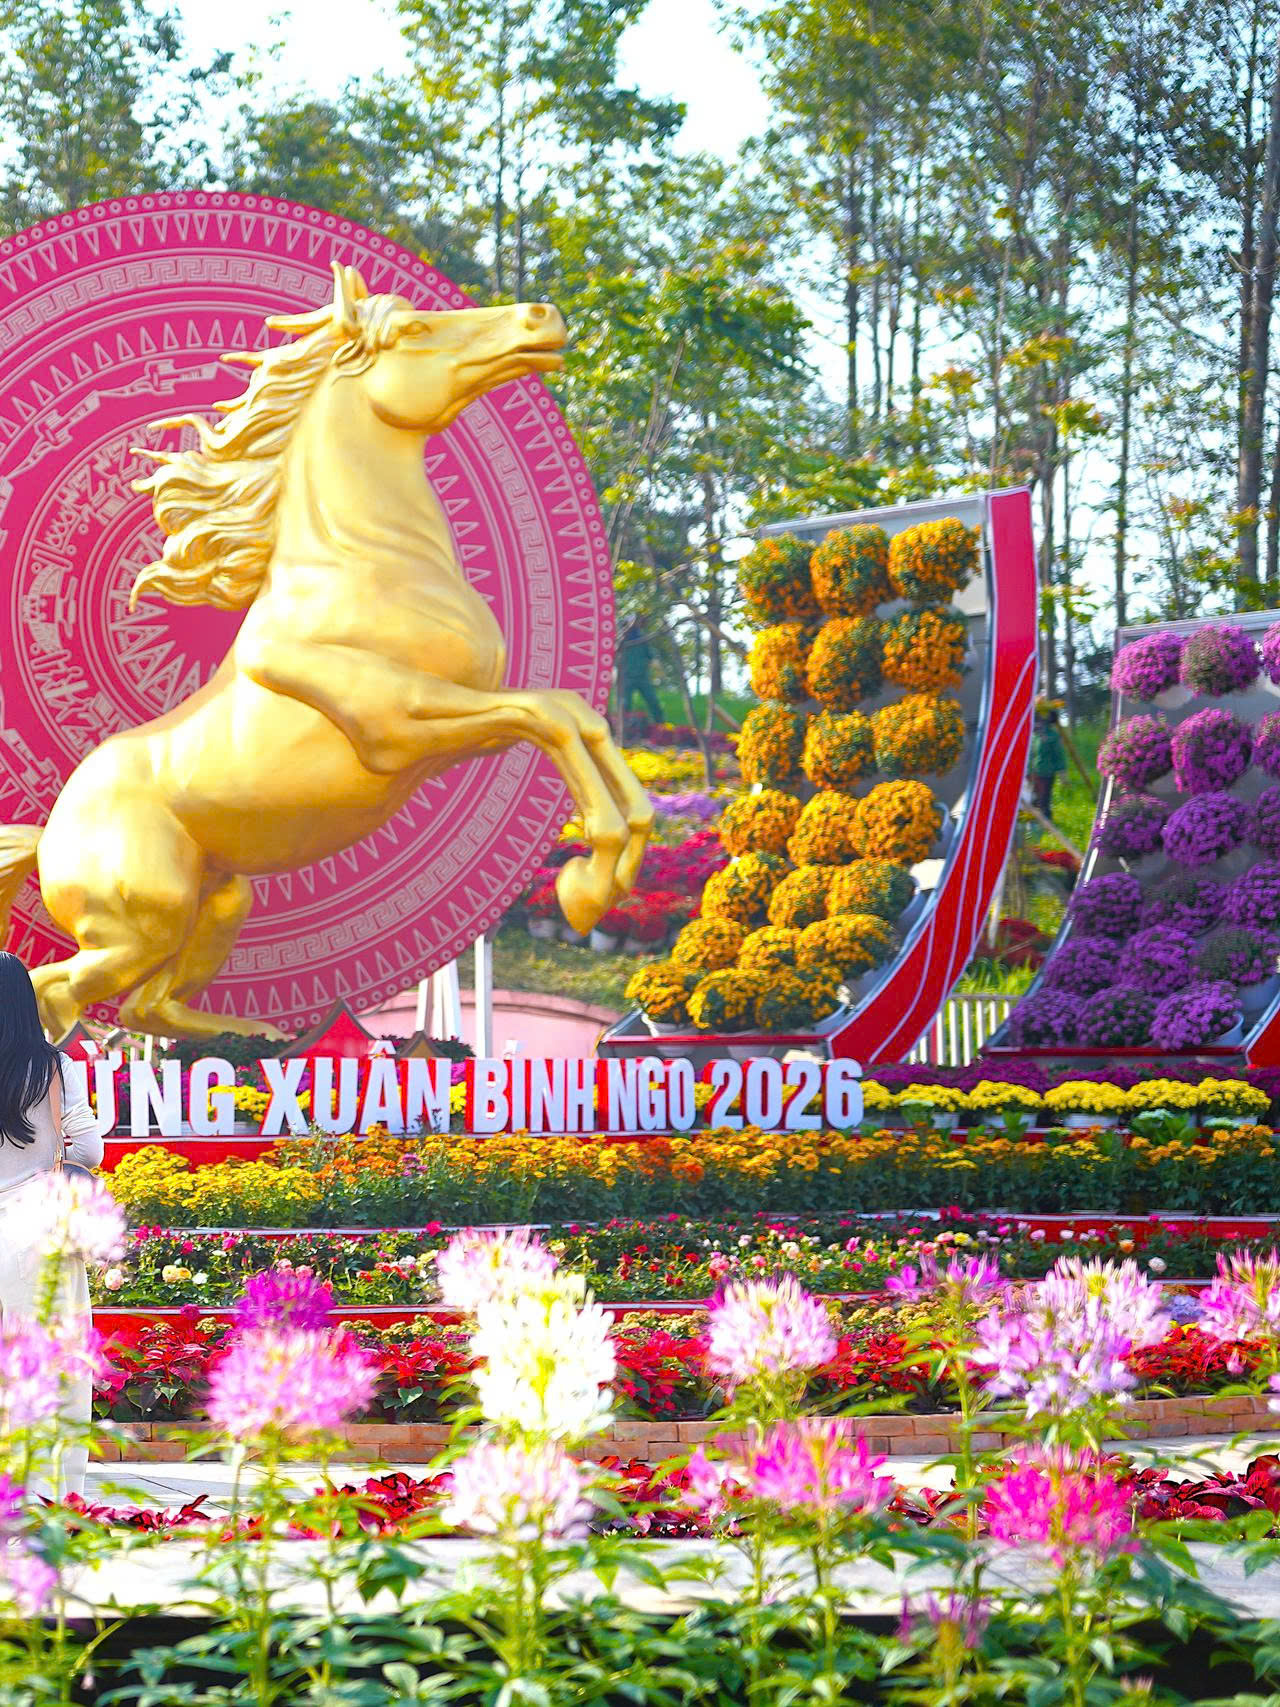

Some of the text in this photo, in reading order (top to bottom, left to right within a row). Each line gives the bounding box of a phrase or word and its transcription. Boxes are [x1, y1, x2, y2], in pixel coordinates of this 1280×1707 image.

[72, 1040, 235, 1137] ỪNG
[260, 1040, 451, 1135] XUÂN
[708, 1057, 865, 1131] 2026
